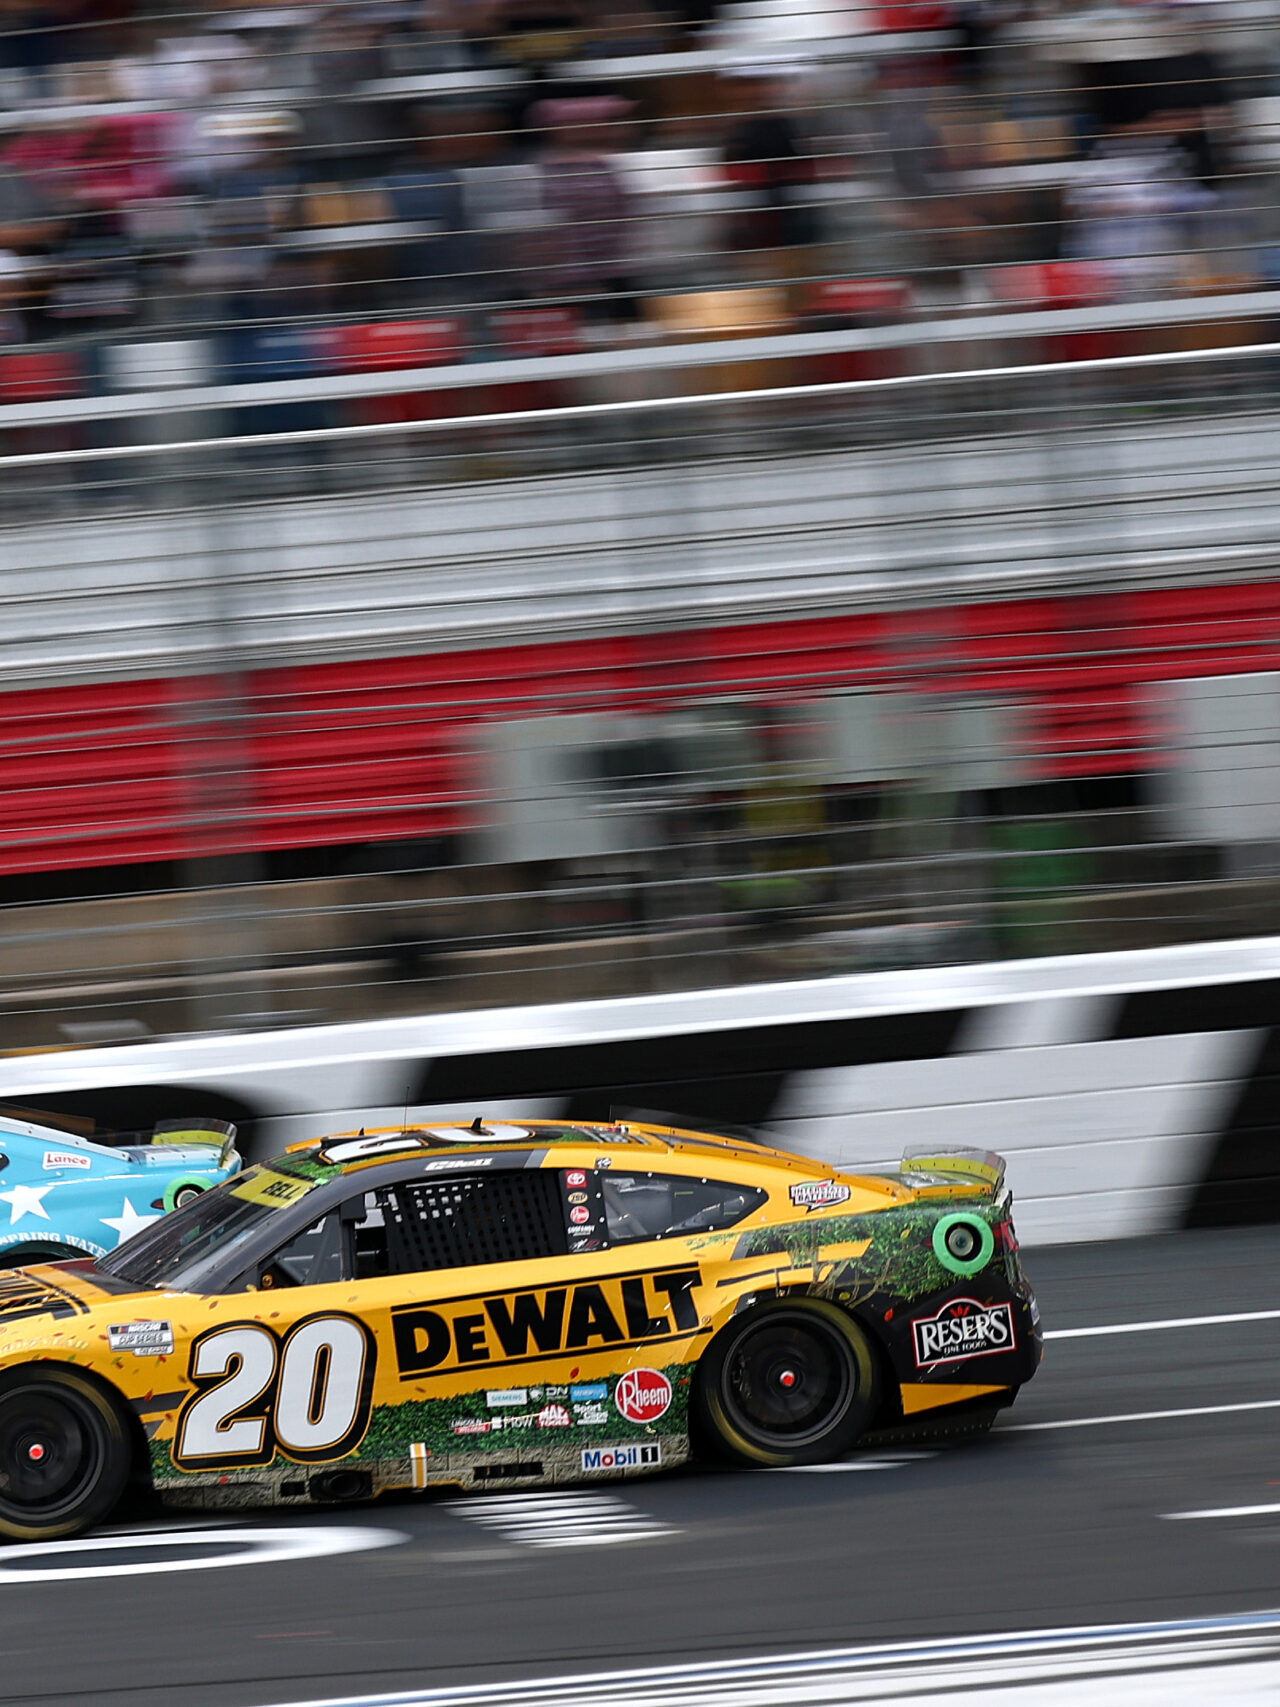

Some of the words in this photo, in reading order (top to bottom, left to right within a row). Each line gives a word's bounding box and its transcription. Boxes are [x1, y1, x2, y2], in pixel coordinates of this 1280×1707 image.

[47, 1153, 88, 1166] Lance
[261, 1181, 301, 1200] BELL
[65, 1233, 109, 1258] WATE
[921, 1309, 1008, 1360] RESER'S
[175, 1313, 373, 1464] 20
[622, 1370, 669, 1415] Rheem
[573, 1403, 602, 1414] Sport
[583, 1447, 637, 1469] Mobil
